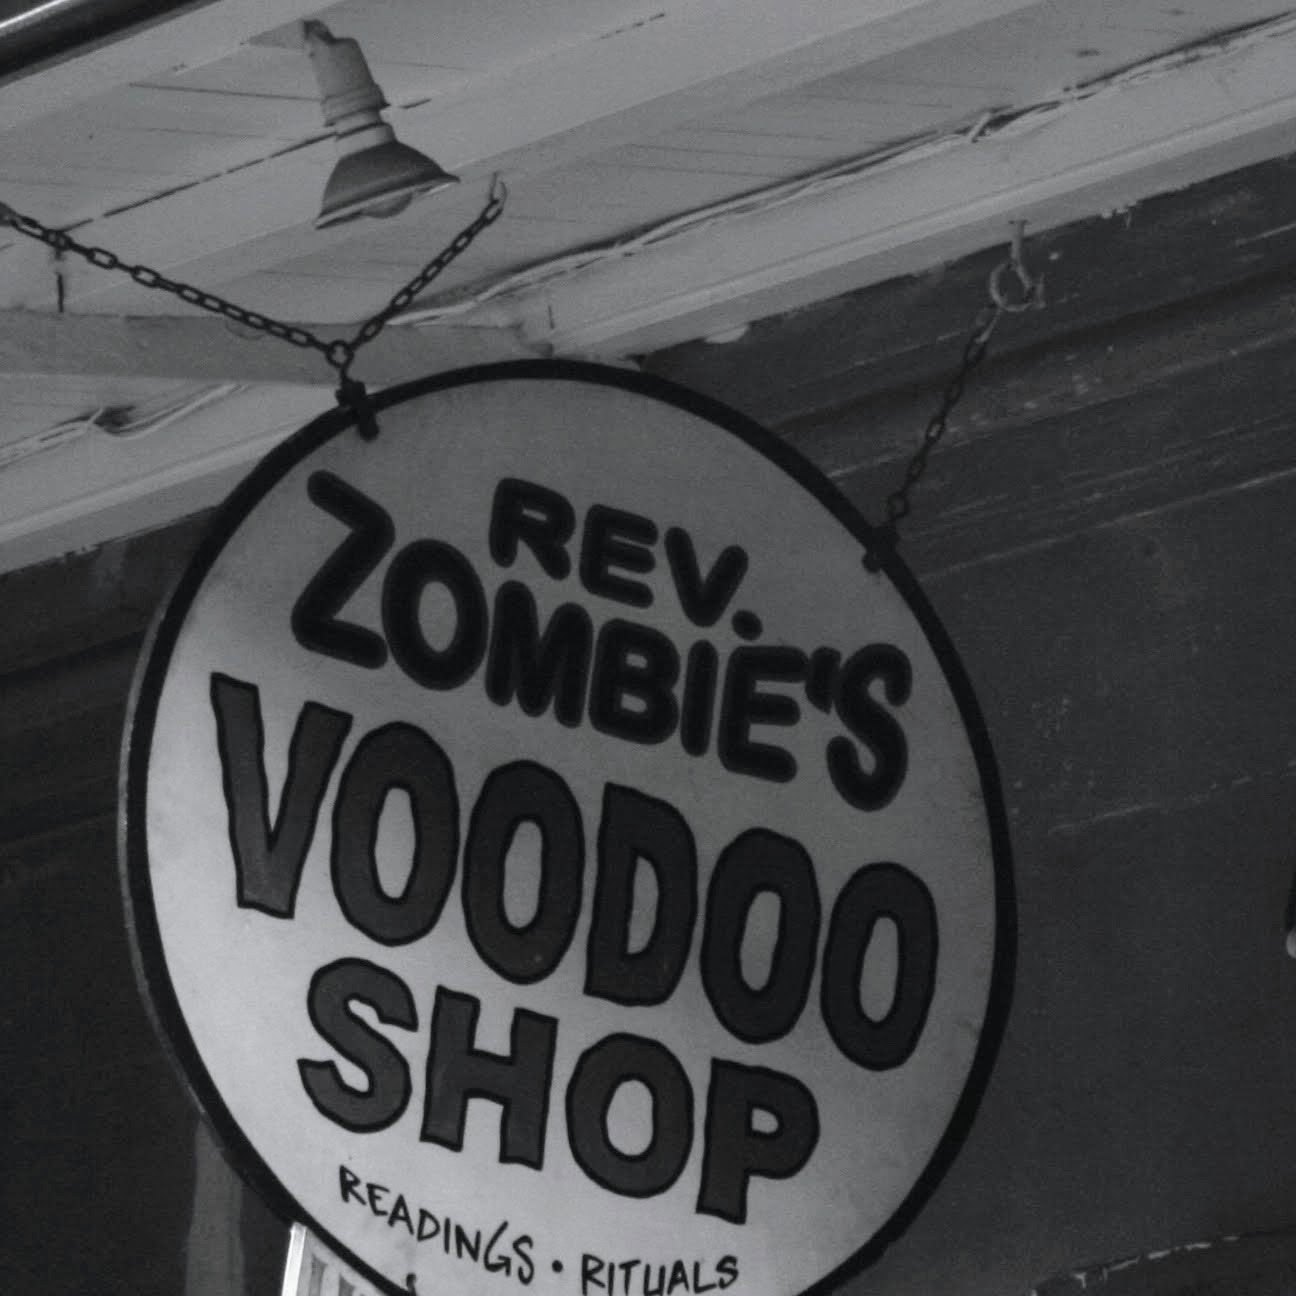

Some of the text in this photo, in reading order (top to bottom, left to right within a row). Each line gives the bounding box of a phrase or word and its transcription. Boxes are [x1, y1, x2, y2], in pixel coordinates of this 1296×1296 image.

[290, 470, 912, 812] ZOMBIE'S
[490, 478, 763, 641] REV.
[210, 672, 938, 1071] VOODOO
[298, 958, 819, 1225] SHOP
[338, 1166, 741, 1296] READINGS RITUALS
